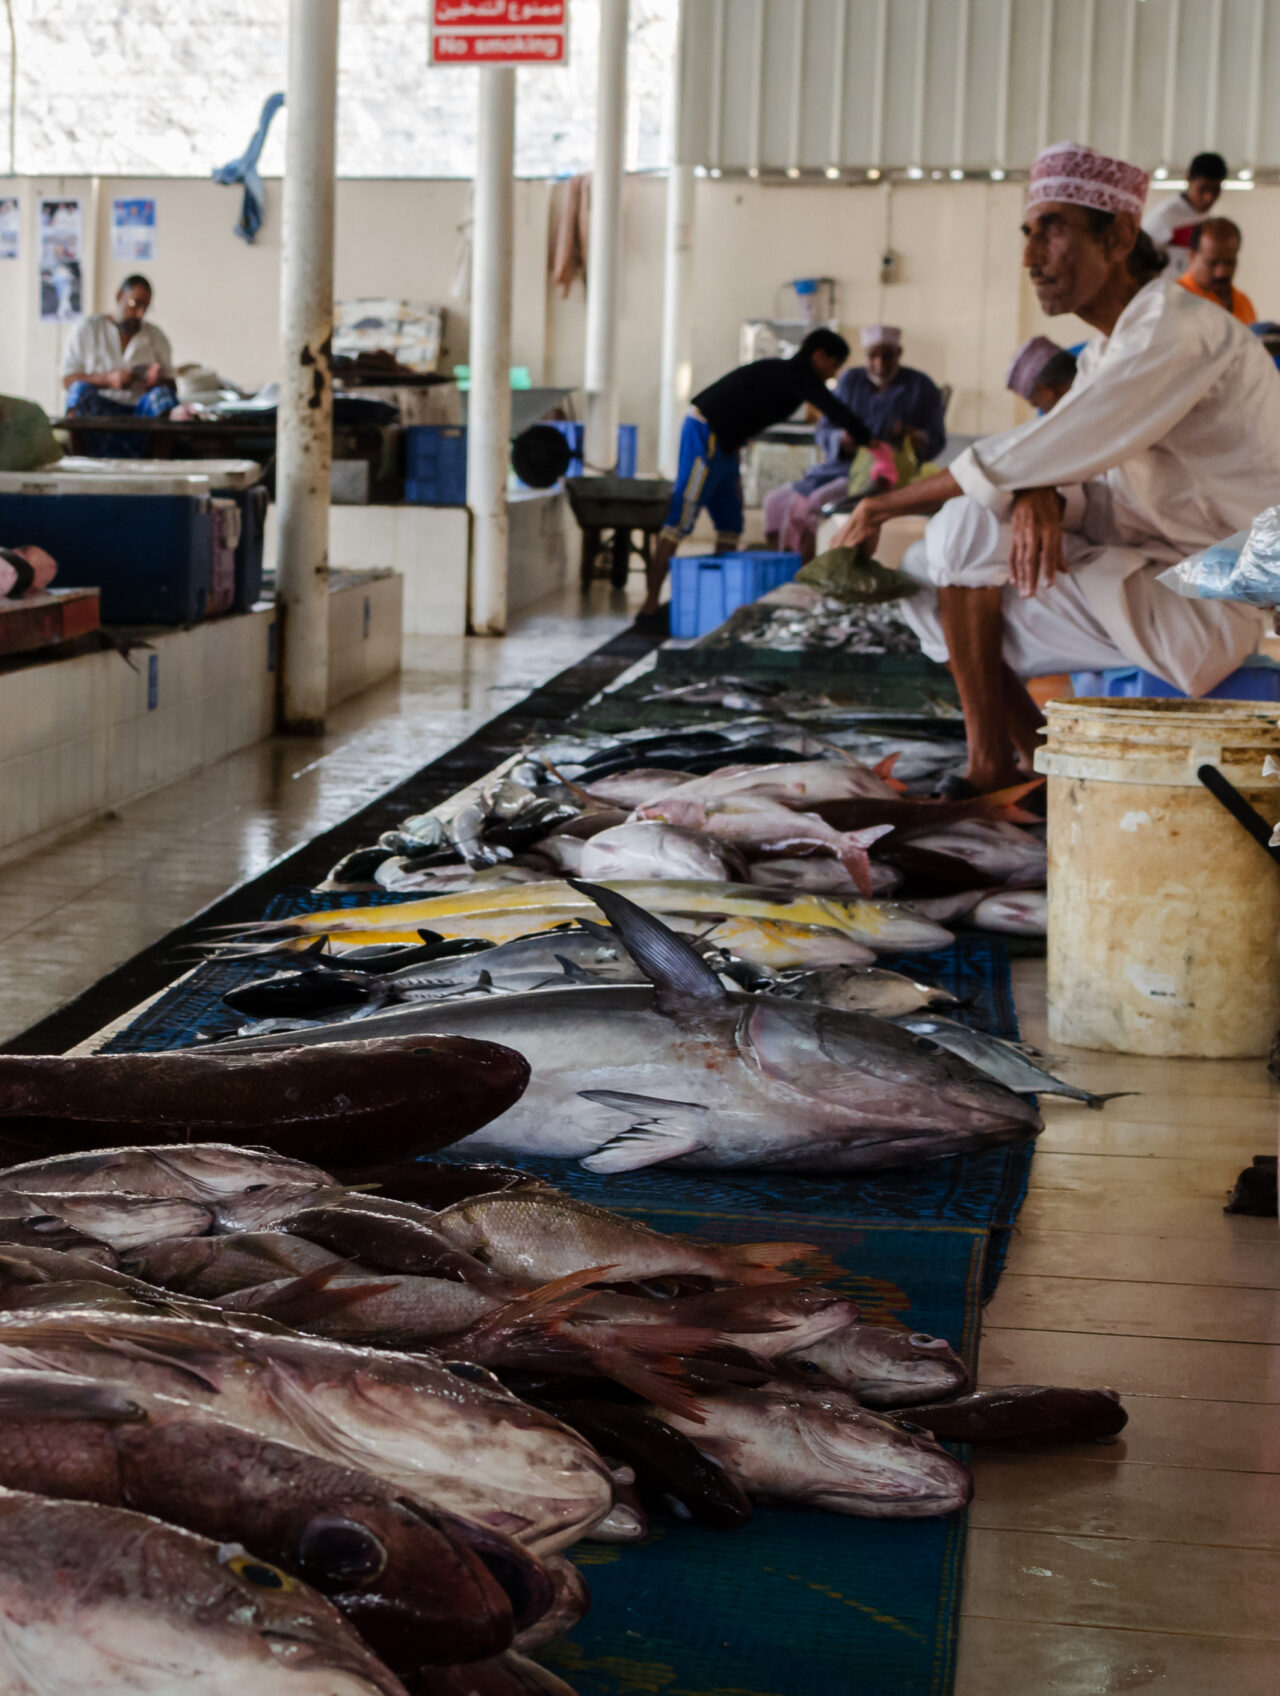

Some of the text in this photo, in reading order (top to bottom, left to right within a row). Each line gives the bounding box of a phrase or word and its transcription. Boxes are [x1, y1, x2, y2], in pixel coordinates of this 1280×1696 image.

[508, 2, 562, 21] ممنوع
[438, 36, 558, 57] No smoking
